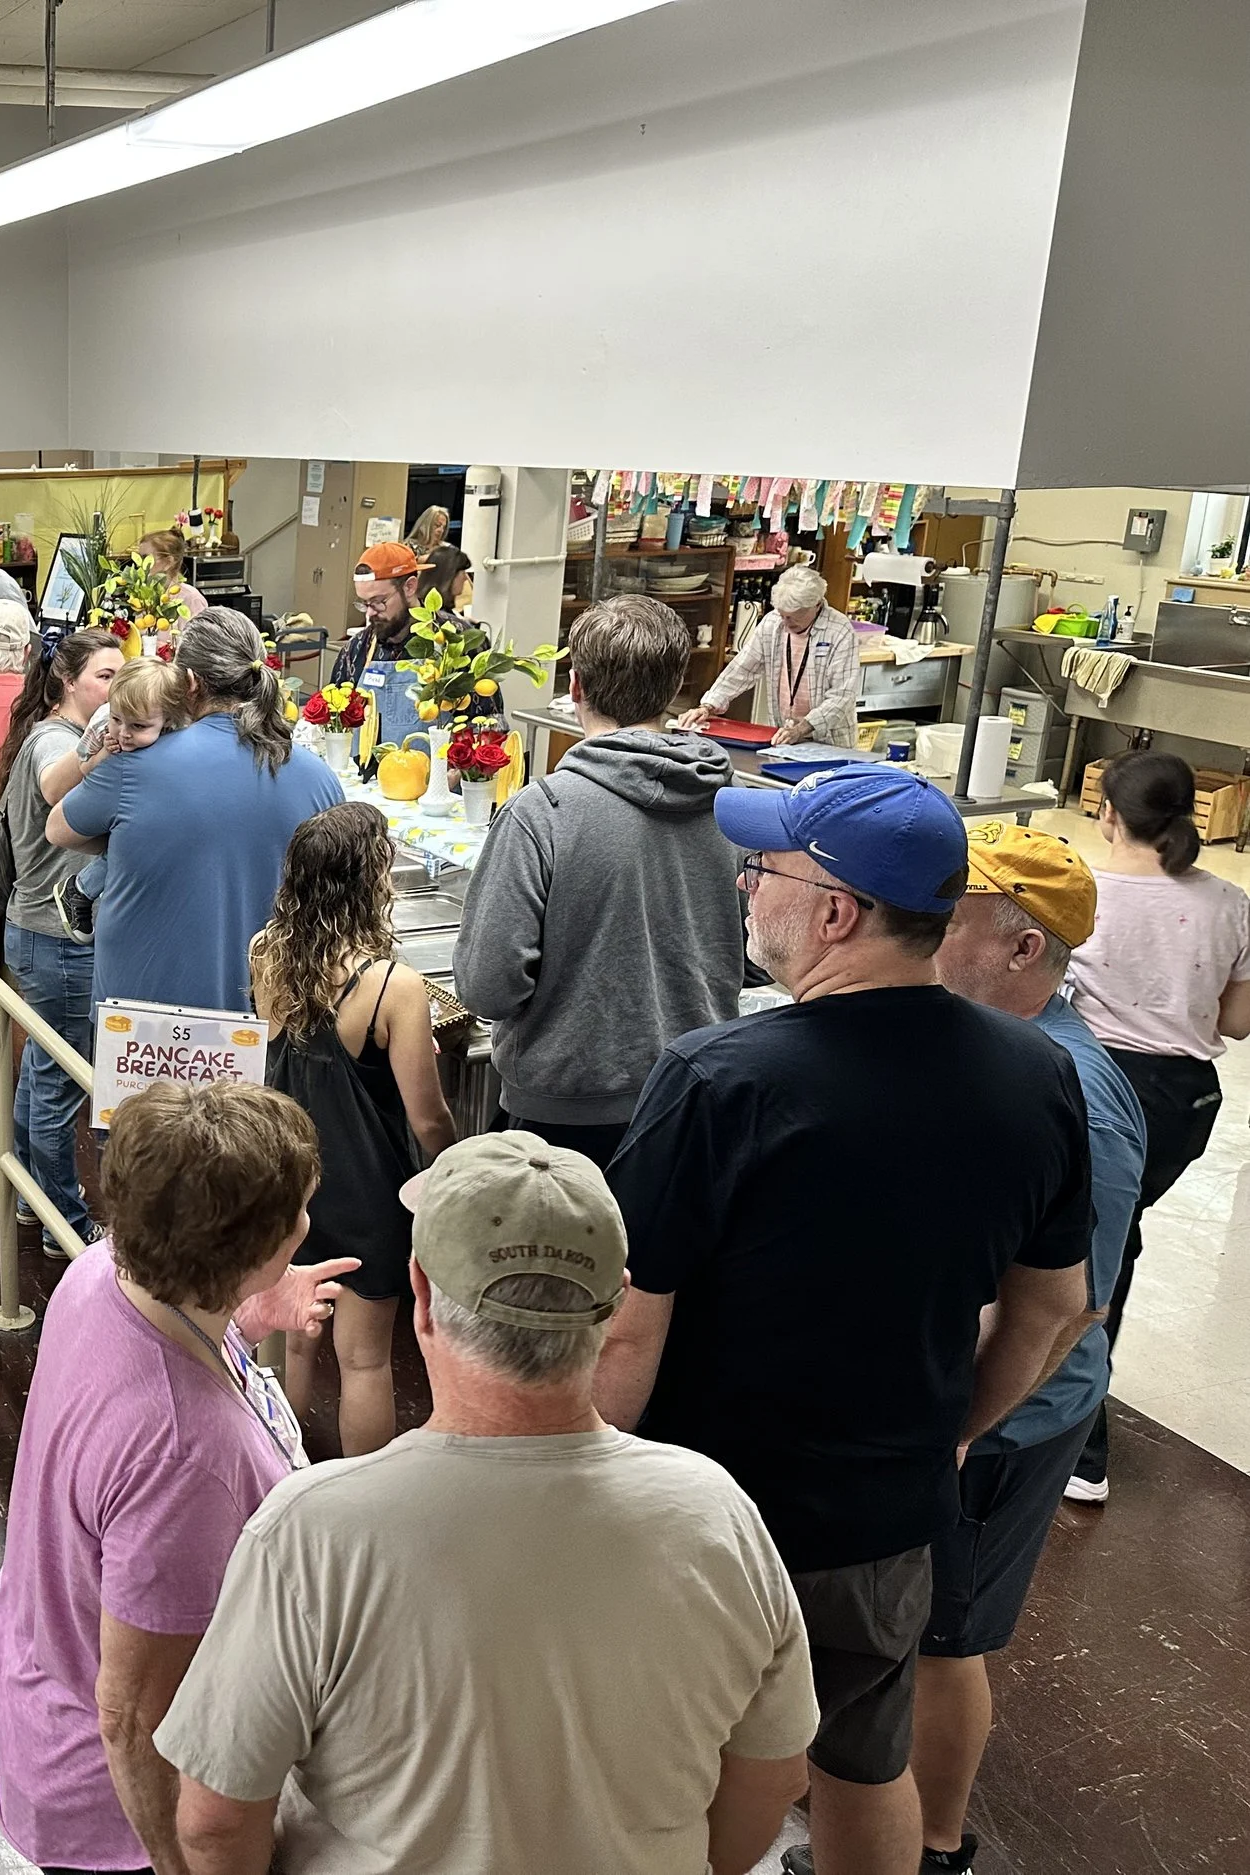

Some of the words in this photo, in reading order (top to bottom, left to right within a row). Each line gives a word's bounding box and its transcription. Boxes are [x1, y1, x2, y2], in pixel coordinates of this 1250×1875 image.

[172, 1025, 191, 1041] $5
[126, 1041, 235, 1069] PANCAKE
[488, 1244, 538, 1264] SOUTH
[543, 1245, 596, 1272] DAKOTA
